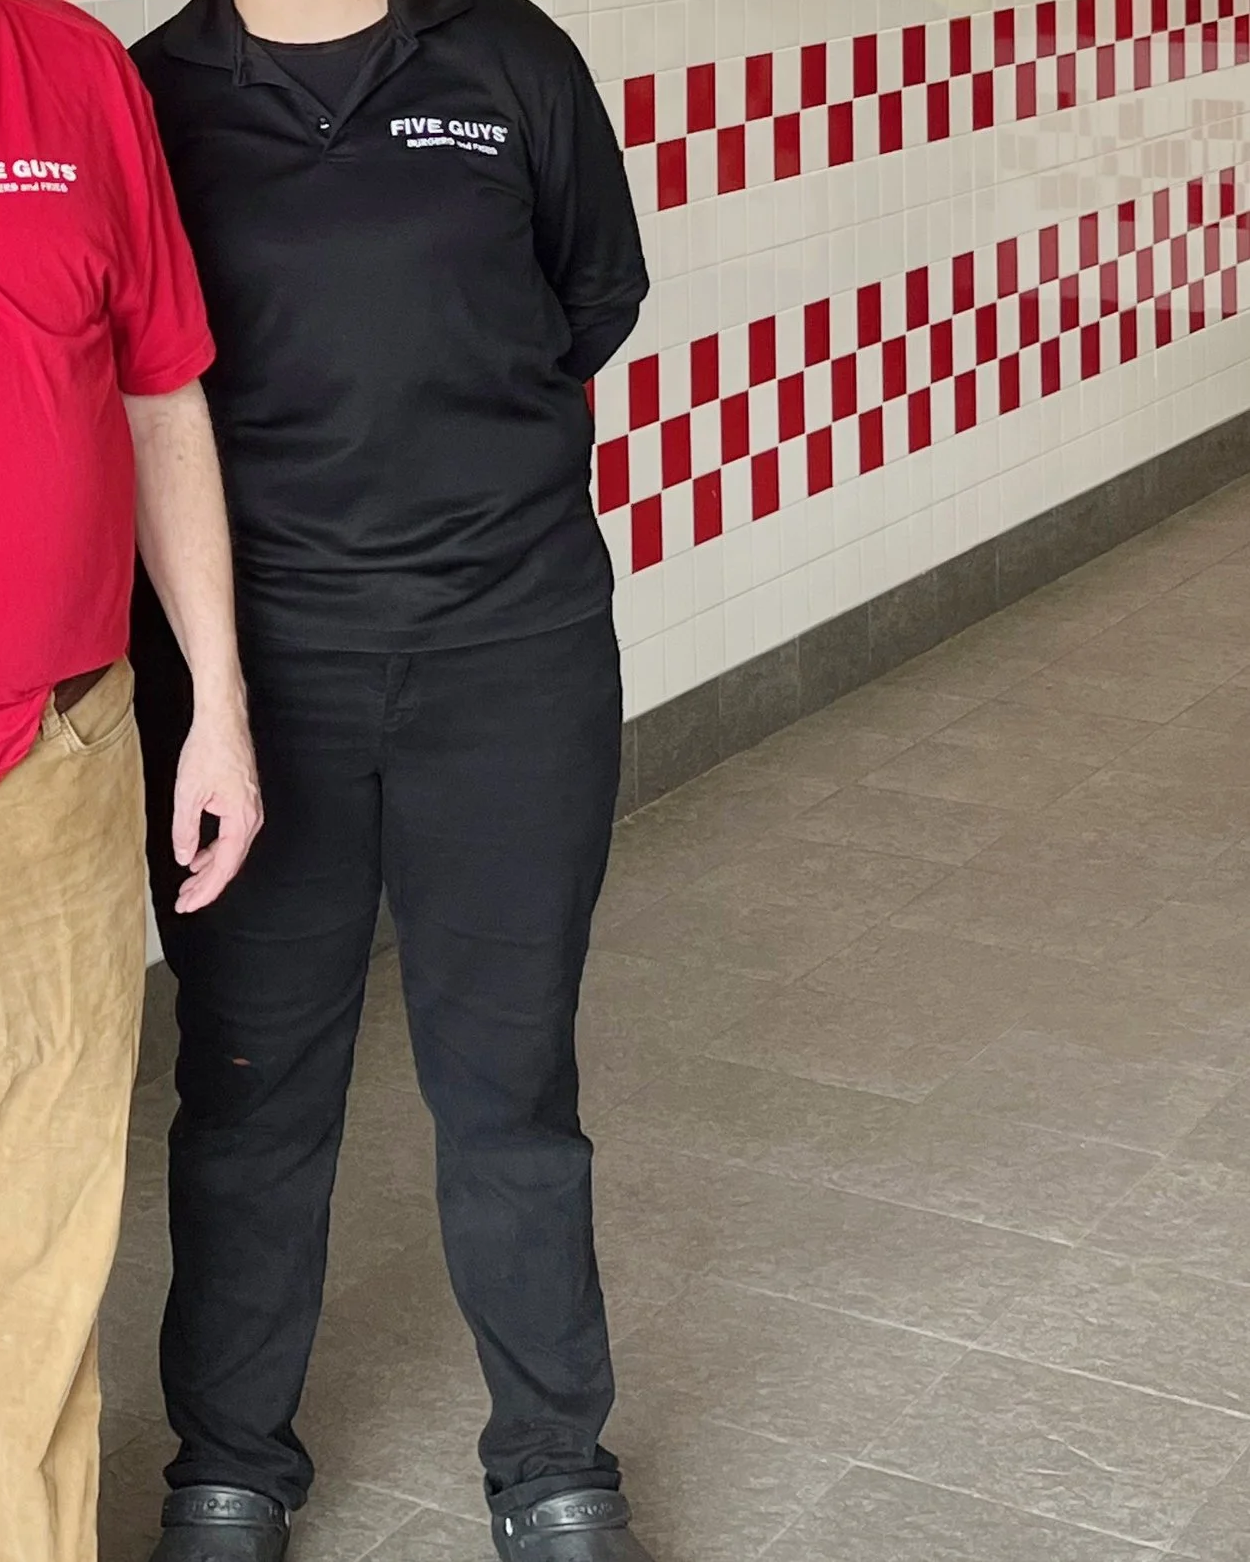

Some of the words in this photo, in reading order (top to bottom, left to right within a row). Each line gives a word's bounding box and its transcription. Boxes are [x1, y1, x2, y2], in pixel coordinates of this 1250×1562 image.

[391, 118, 444, 136] FIVE
[448, 120, 507, 142] GUYS
[12, 159, 77, 182] GUYS
[20, 182, 39, 191] and
